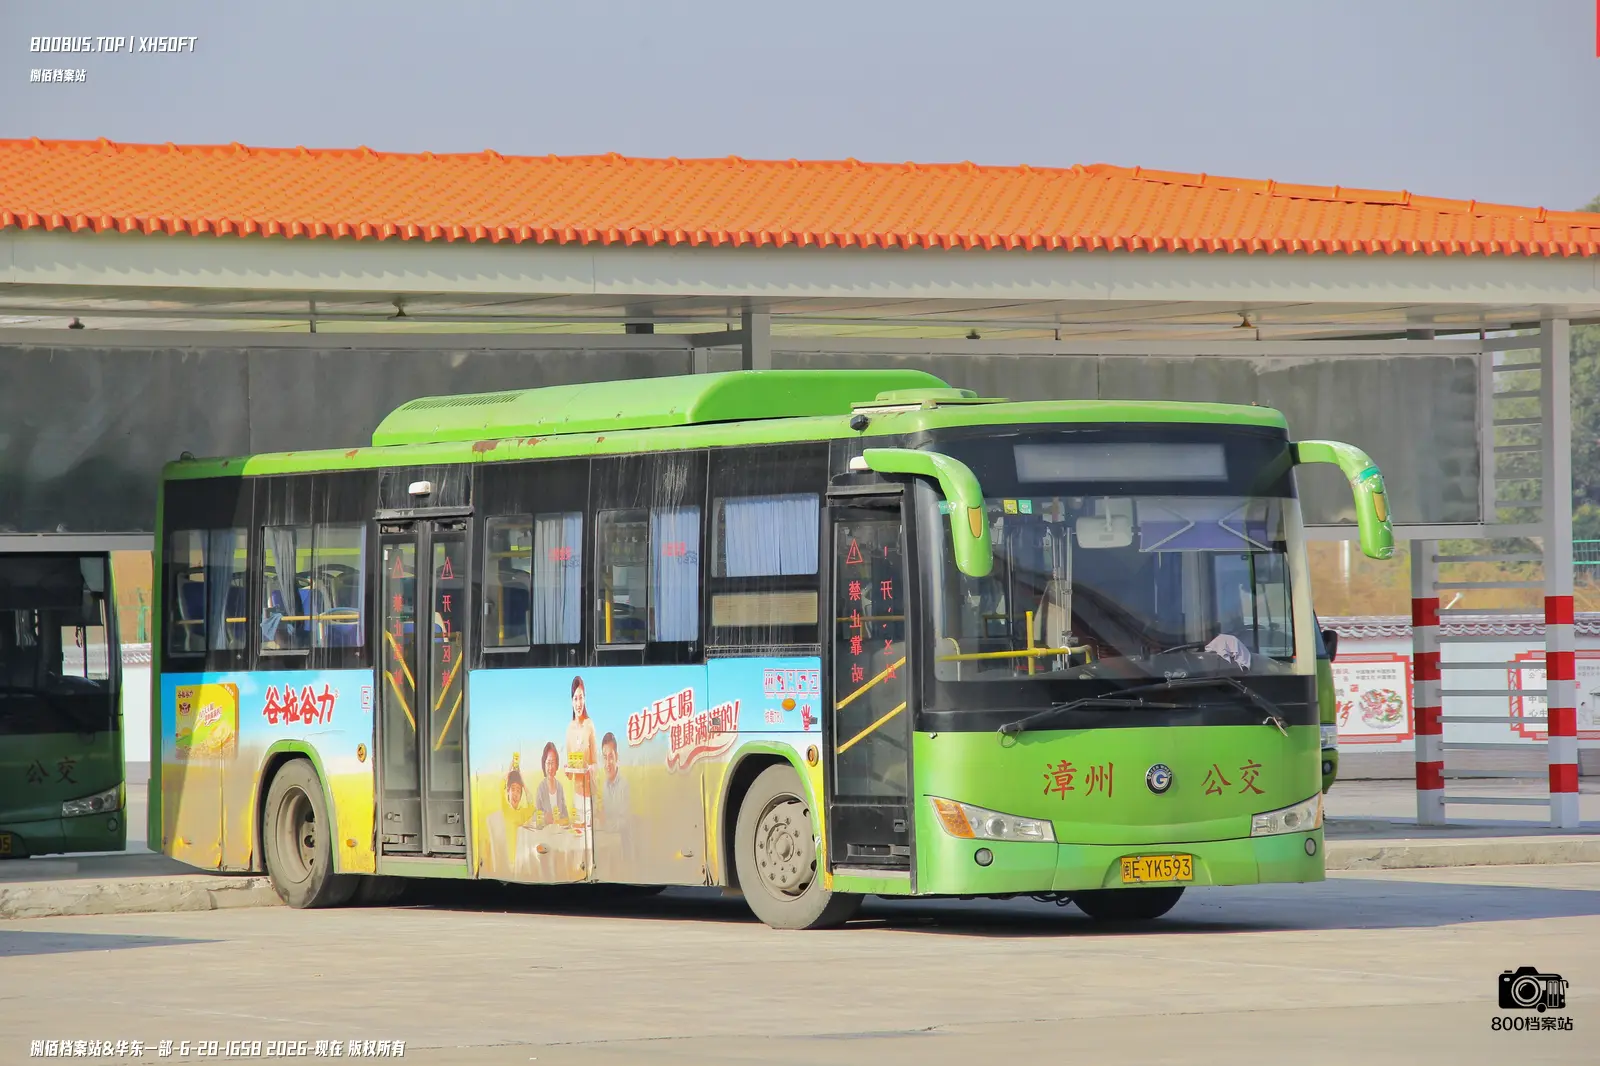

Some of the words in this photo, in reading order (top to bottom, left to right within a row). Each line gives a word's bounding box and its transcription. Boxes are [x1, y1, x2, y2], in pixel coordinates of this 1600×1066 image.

[263, 684, 335, 725] 谷粒谷力
[26, 756, 78, 784] 公交
[1043, 759, 1114, 800] 漳州
[1201, 759, 1265, 796] 公交
